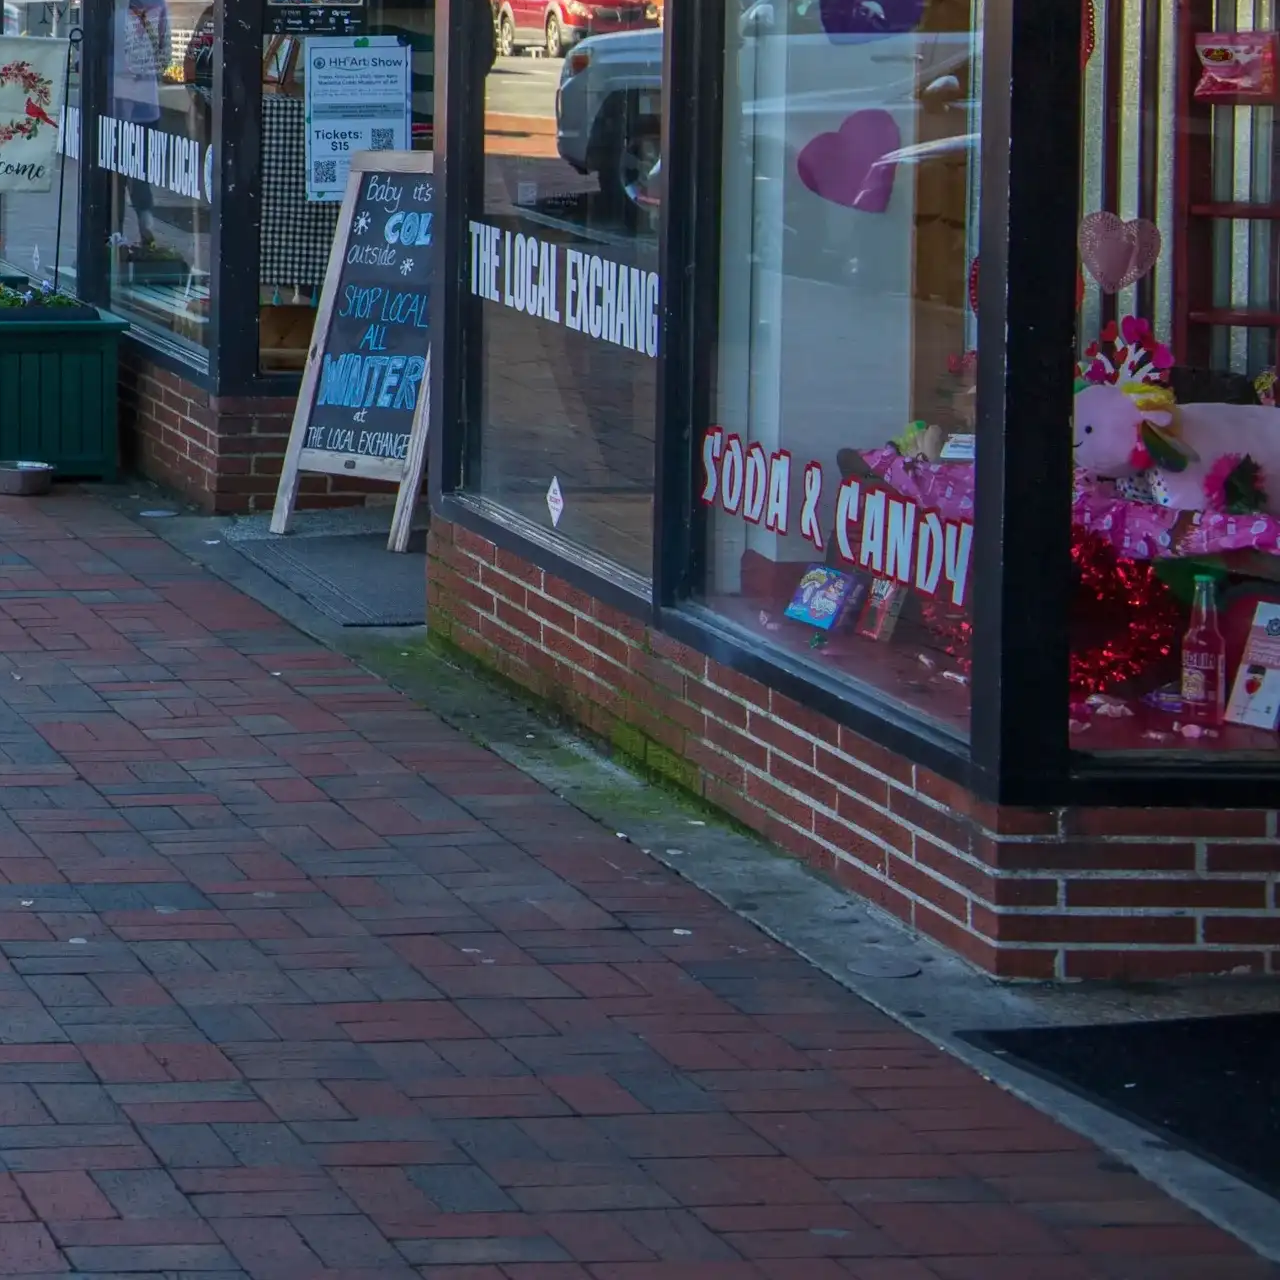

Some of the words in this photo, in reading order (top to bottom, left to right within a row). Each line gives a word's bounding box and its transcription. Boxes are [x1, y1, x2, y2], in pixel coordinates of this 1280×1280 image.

[350, 57, 367, 67] Art
[371, 57, 403, 67] Show
[314, 129, 363, 140] Tickets:
[330, 141, 349, 152] $15
[98, 114, 117, 172] LIVE
[118, 119, 146, 181] LOCAL
[148, 128, 168, 188] BUY
[169, 134, 201, 200] LOCAL
[366, 175, 403, 213] Baby
[413, 183, 433, 202] it's
[384, 211, 433, 246] COL
[347, 243, 396, 266] outside
[339, 284, 381, 318] SHOP
[381, 287, 428, 328] LOCAL
[469, 220, 500, 302] THE
[504, 230, 559, 323] LOCAL
[566, 248, 659, 358] EXCHANG
[359, 323, 387, 351] ALL
[317, 353, 426, 410] WINTER
[352, 408, 366, 423] at
[307, 426, 325, 449] THE
[327, 426, 355, 453] LOCAL
[357, 431, 411, 460] EXCHANGE
[700, 425, 792, 536] SODA
[800, 460, 824, 552] &
[835, 475, 975, 608] CANDY
